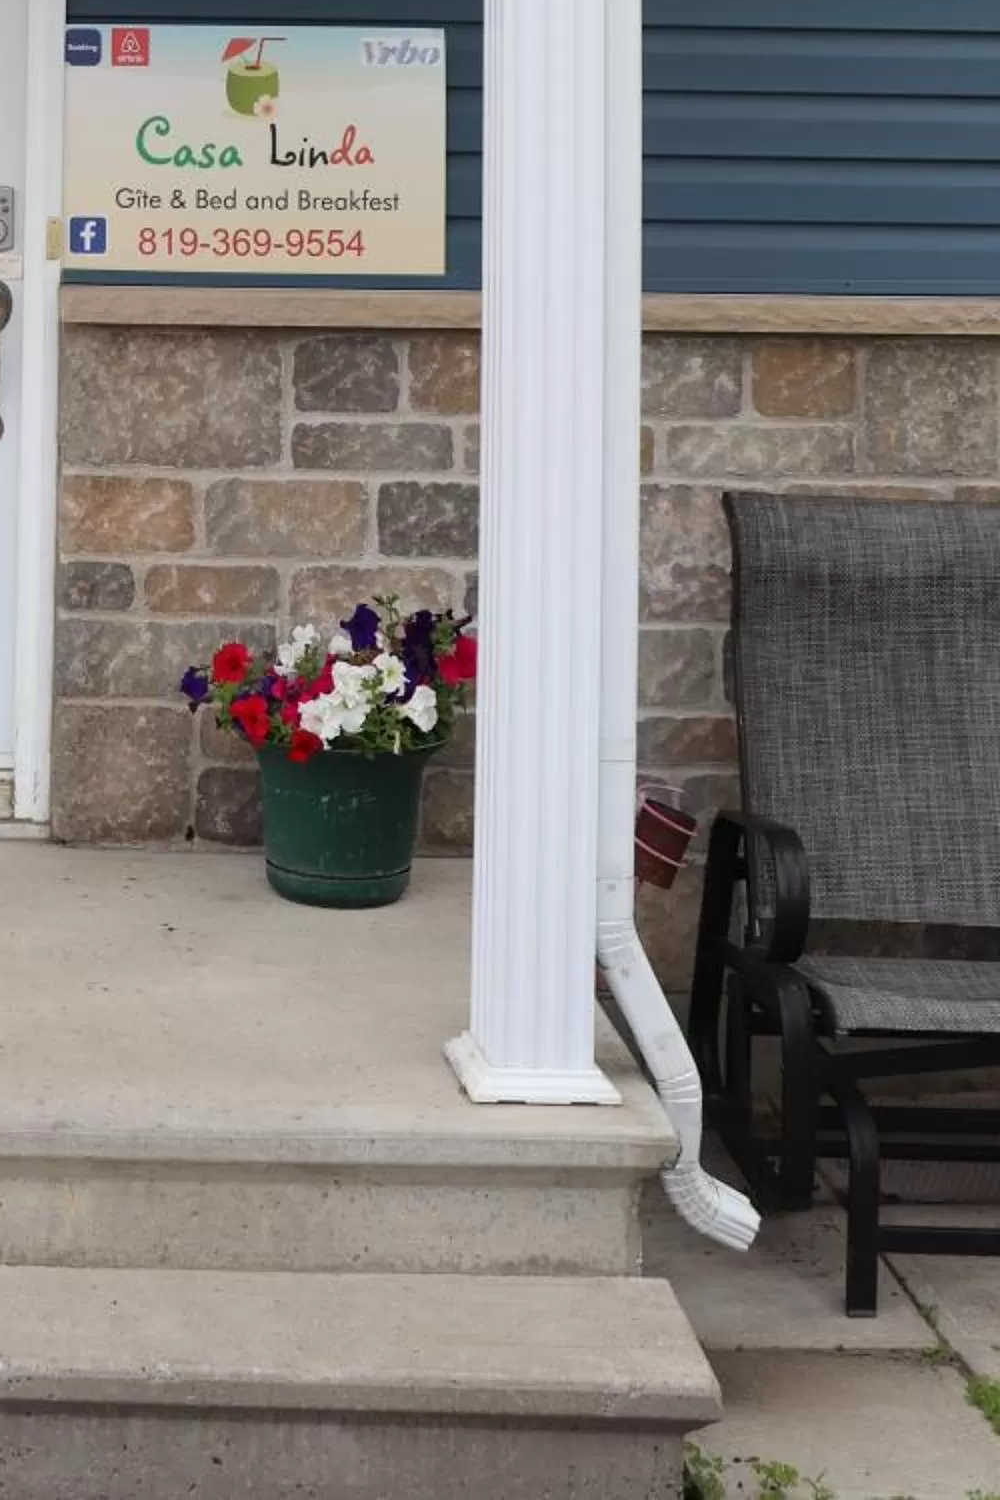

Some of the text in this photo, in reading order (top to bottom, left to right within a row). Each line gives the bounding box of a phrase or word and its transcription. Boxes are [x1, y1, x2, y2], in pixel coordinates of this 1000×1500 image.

[135, 115, 375, 169] Casa Linda
[115, 187, 399, 211] Gîte & Bed and Breakfest
[138, 227, 365, 257] 819-369-9554
